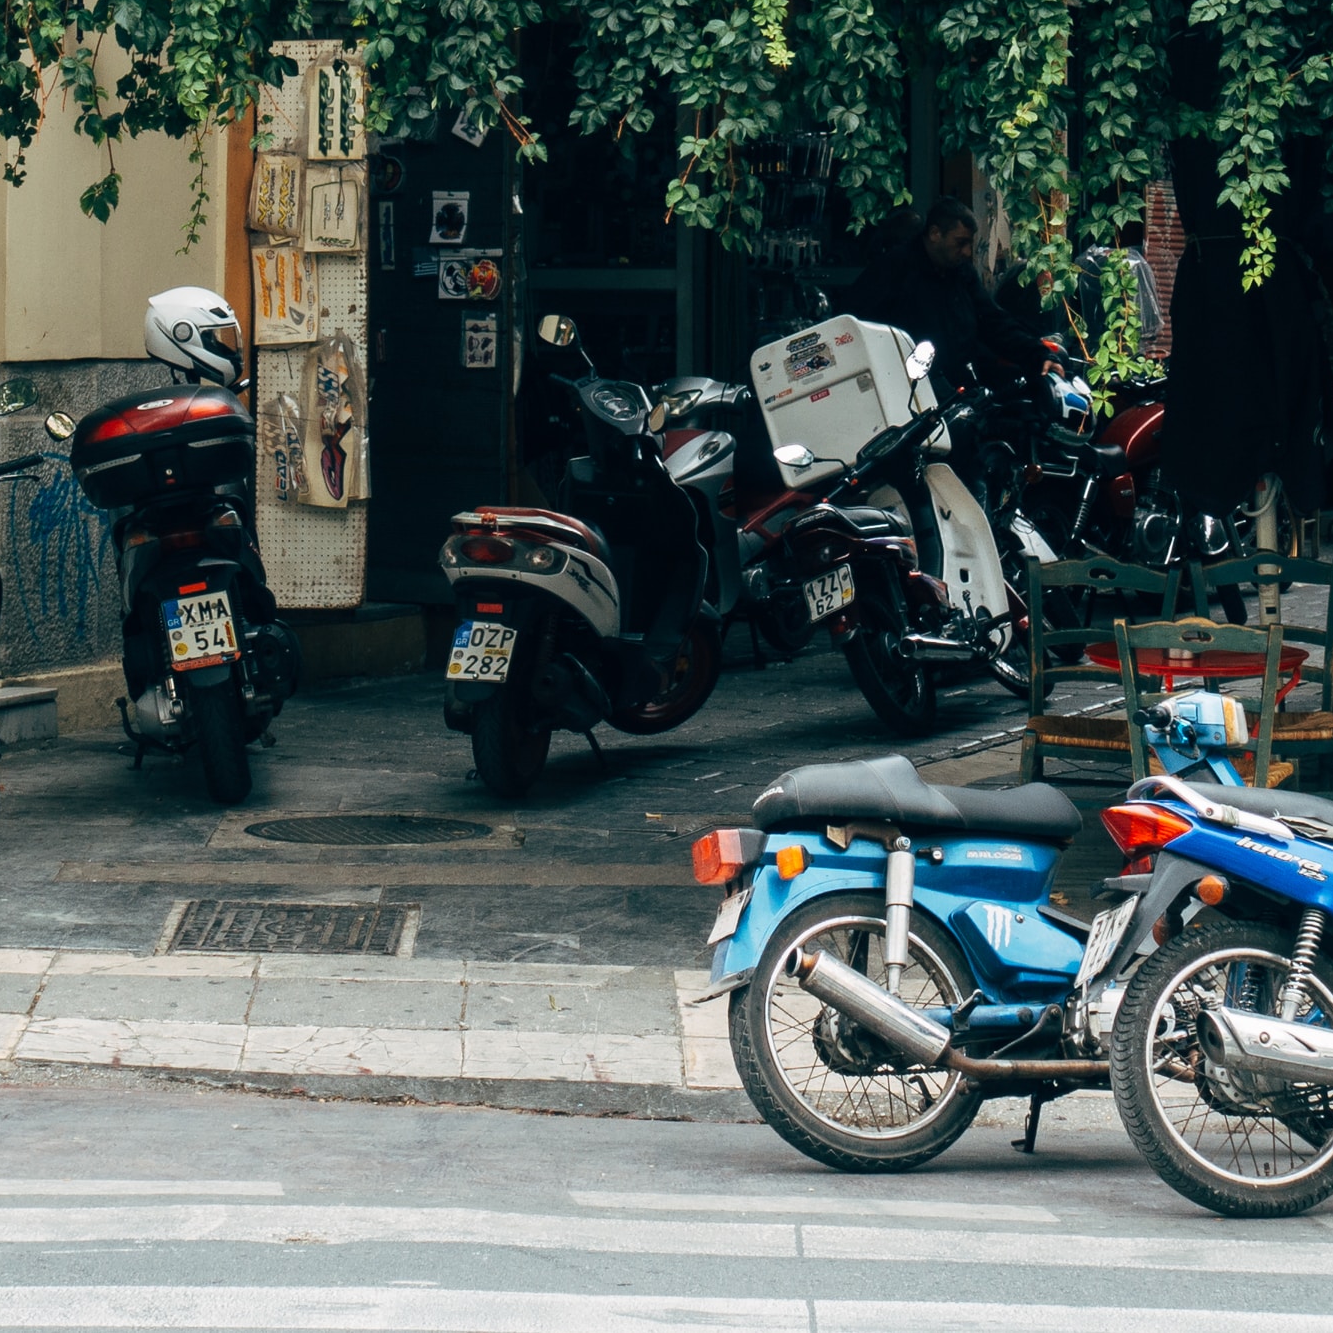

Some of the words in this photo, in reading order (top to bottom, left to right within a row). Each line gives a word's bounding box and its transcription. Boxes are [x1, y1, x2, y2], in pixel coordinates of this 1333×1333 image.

[182, 598, 229, 625] XMA
[816, 594, 835, 616] 62
[168, 619, 180, 628] GR
[194, 628, 225, 651] 54
[455, 637, 468, 645] GR
[463, 655, 508, 676] 282
